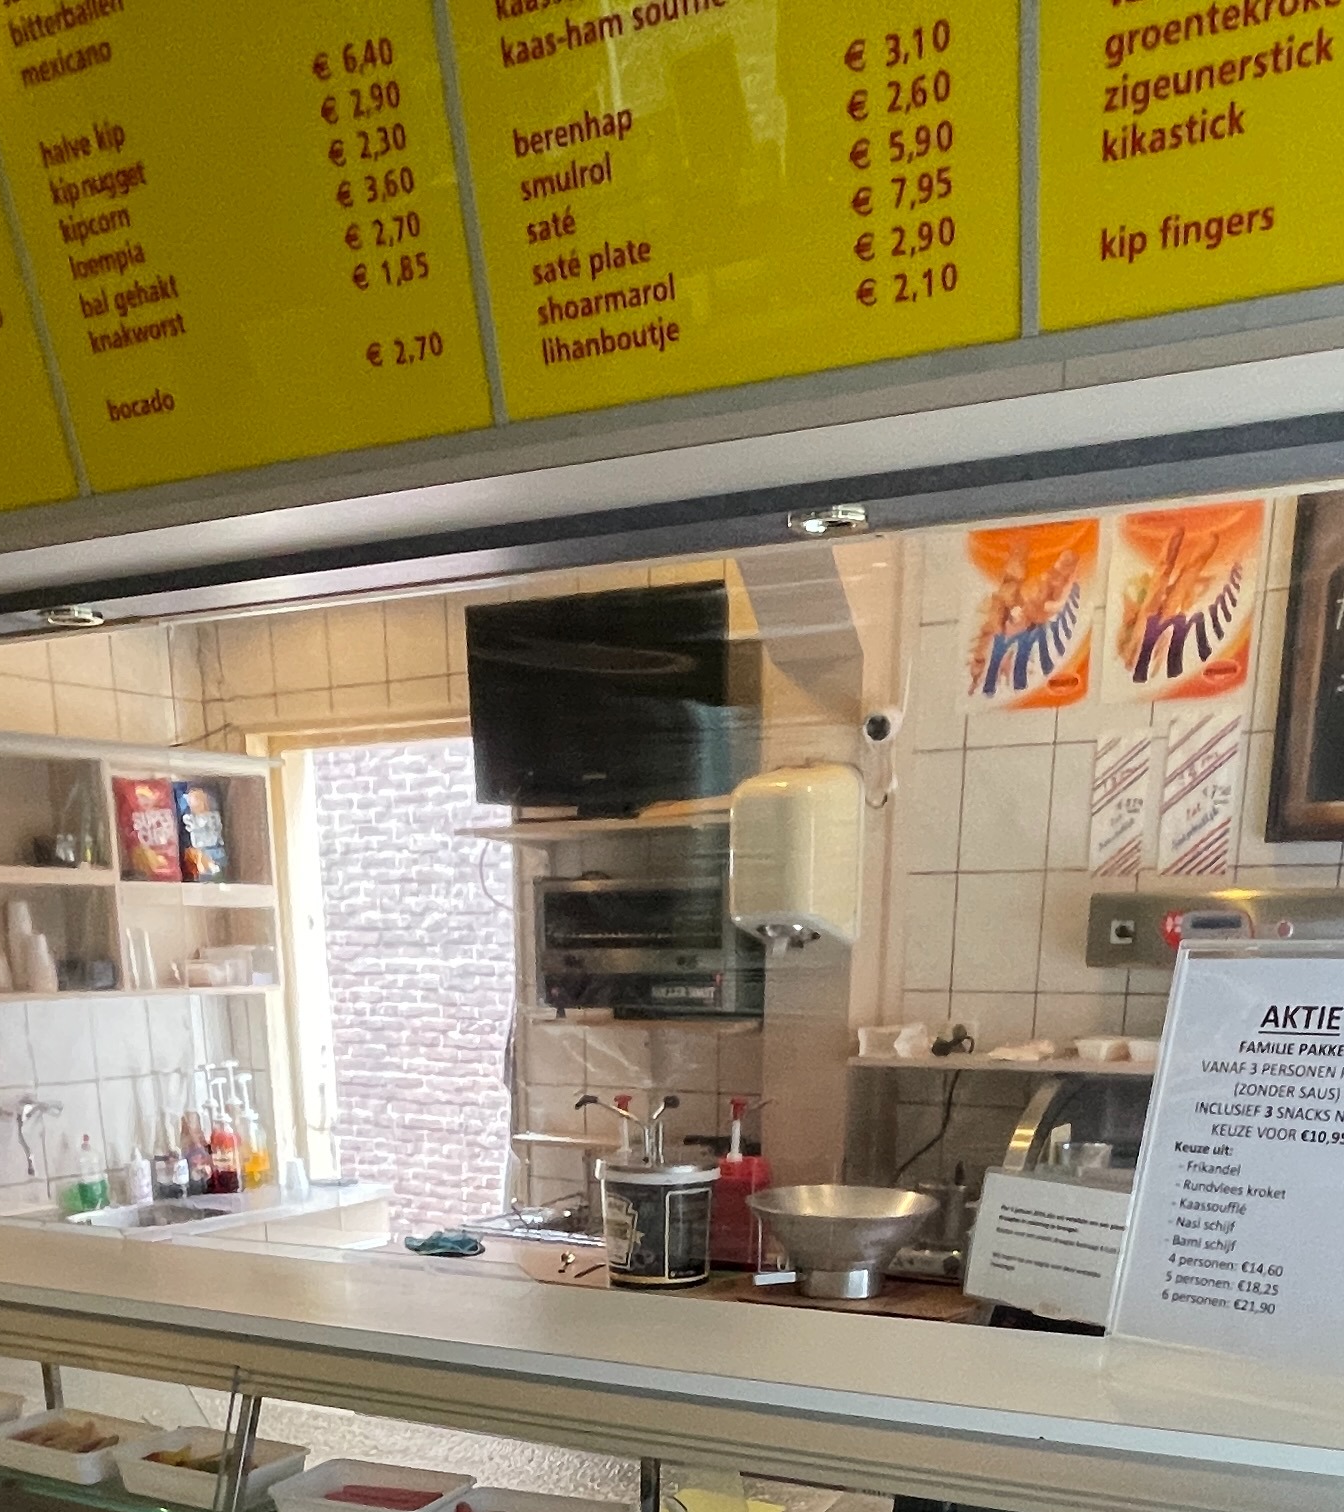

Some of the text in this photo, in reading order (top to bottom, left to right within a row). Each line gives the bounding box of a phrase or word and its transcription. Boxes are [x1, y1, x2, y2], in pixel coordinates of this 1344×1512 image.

[313, 37, 394, 81] € 6,40
[501, 13, 622, 68] kaas-ham
[844, 18, 951, 72] € 3,10
[21, 42, 111, 88] mexicano
[1104, 28, 1334, 113] zigeunerstick
[321, 80, 400, 125] € 2,90
[846, 69, 951, 121] € 2,60
[40, 120, 126, 169] halve kip
[328, 123, 406, 168] € 2,30
[513, 105, 633, 158] berenhap
[849, 120, 953, 169] € 5,90
[1101, 101, 1246, 163] kikastick
[336, 166, 415, 208] € 3,60
[521, 152, 612, 201] smulrol
[851, 166, 952, 216] € 7,95
[59, 207, 131, 245] kipcorn
[345, 211, 421, 250] € 2,70
[527, 205, 576, 245] saté
[854, 216, 955, 262] € 2,90
[1100, 202, 1274, 262] kip fingers
[68, 241, 146, 281] loempia
[381, 252, 429, 288] 1,85
[532, 237, 652, 286] saté plate
[79, 274, 179, 319] bal gehakt
[537, 273, 675, 326] shoarmarol
[856, 262, 957, 306] € 2,10
[88, 312, 186, 354] knakworst
[366, 331, 444, 367] € 2,70
[106, 388, 175, 422] bocado
[1260, 1005, 1344, 1031] AKTIE
[1202, 1060, 1247, 1075] VANAF
[1250, 1063, 1258, 1076] 3
[1261, 1063, 1336, 1079] PERSONEN
[1239, 1041, 1295, 1056] FAMILIE
[1195, 1102, 1261, 1118] INCLUSIEF
[1264, 1106, 1273, 1118] 3
[1276, 1106, 1331, 1123] SNACKS
[1234, 1082, 1341, 1102] (ZONDER SAUS)
[1174, 1141, 1233, 1157] Keuze uit:
[1211, 1124, 1253, 1139] KEUZE
[1257, 1126, 1296, 1141] VOOR
[1183, 1179, 1286, 1200] Rundvlees kroket
[1186, 1160, 1242, 1177] Frikandel
[1172, 1234, 1237, 1254] Bami schijf
[1176, 1216, 1236, 1235] Nasi schijf
[1165, 1270, 1173, 1282] 5
[1237, 1279, 1279, 1296] €18,25
[1168, 1253, 1176, 1264] 4
[1241, 1260, 1284, 1277] €14,60
[1161, 1288, 1169, 1300] 6
[1233, 1298, 1276, 1315] €21,90
